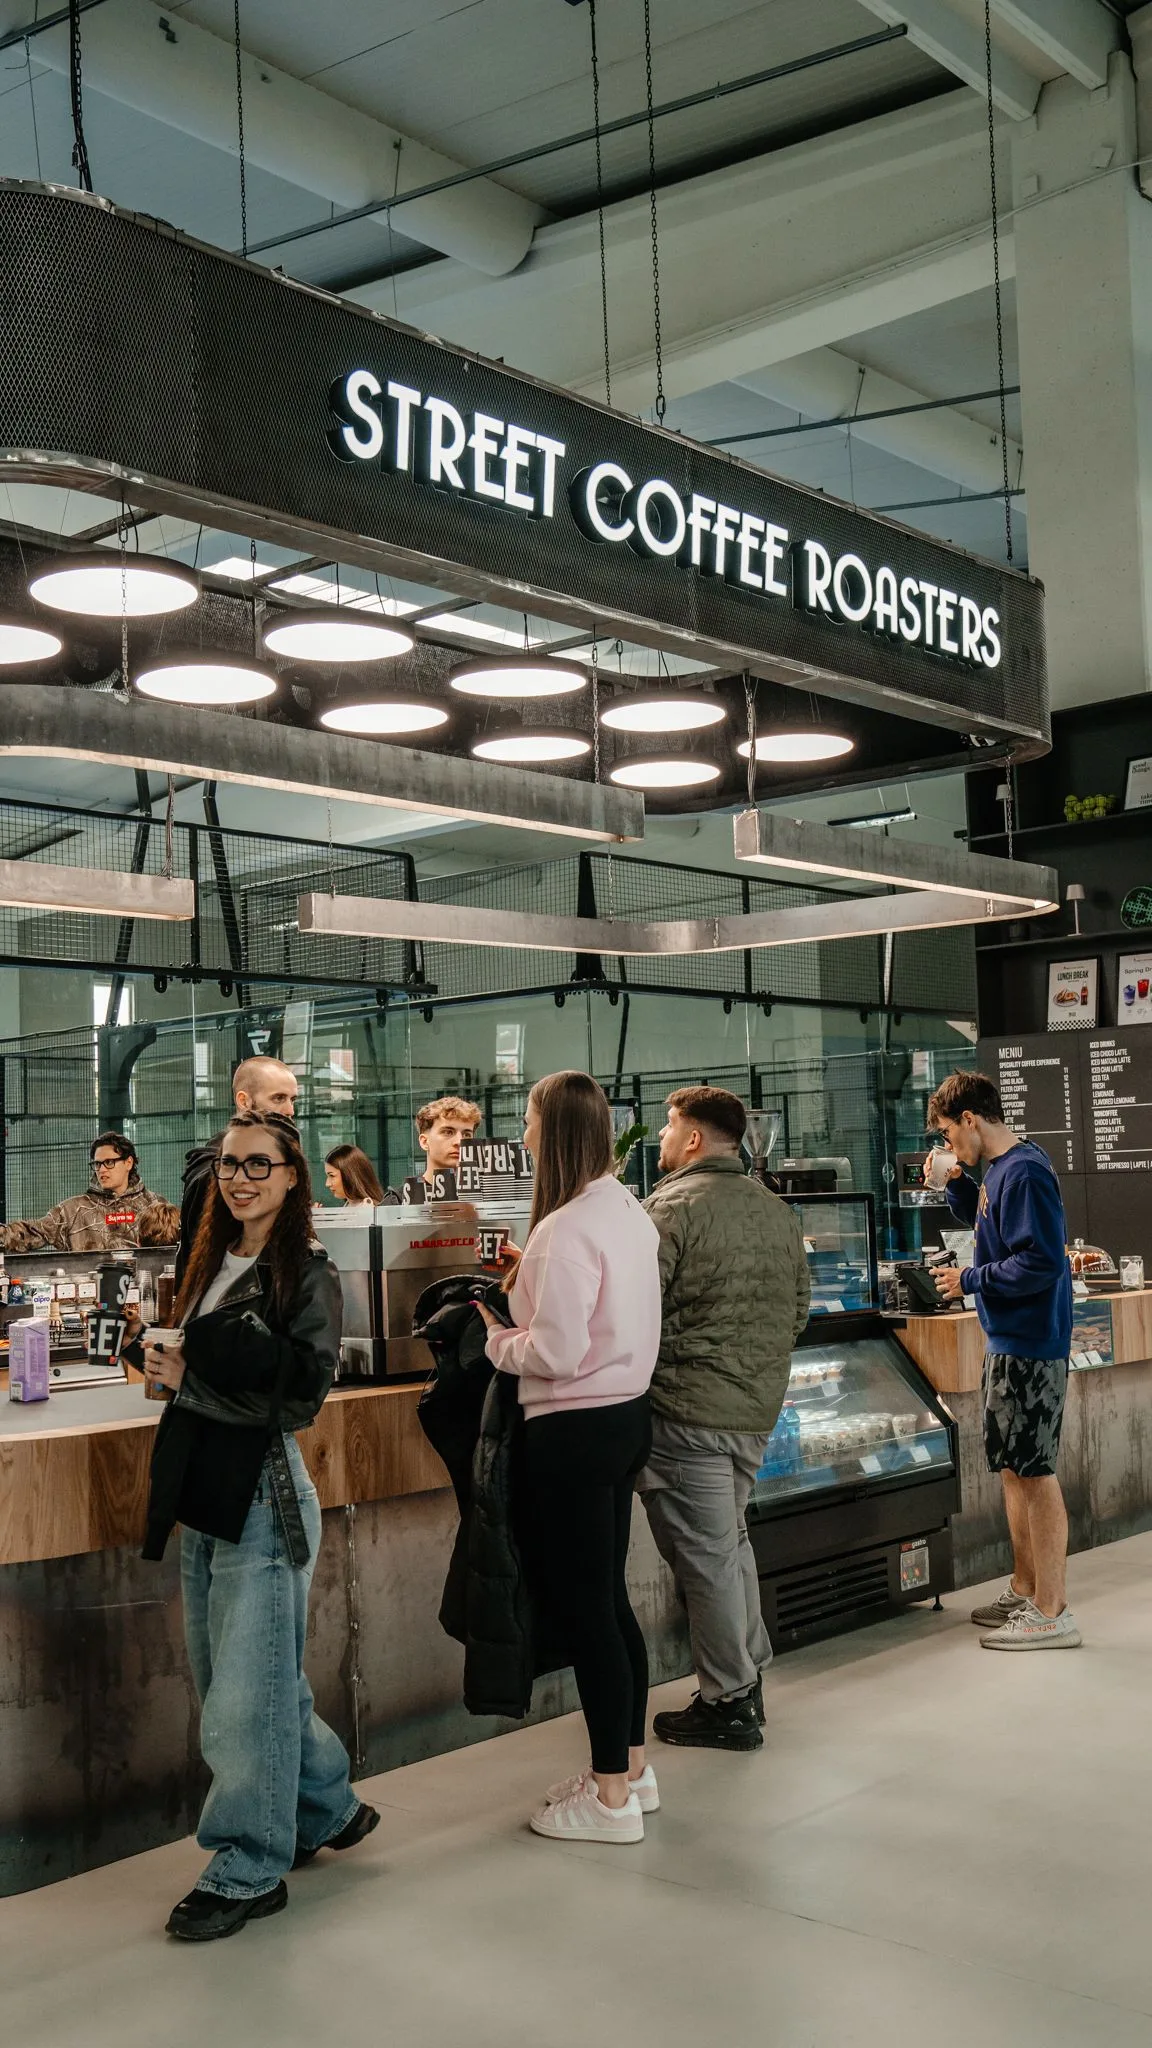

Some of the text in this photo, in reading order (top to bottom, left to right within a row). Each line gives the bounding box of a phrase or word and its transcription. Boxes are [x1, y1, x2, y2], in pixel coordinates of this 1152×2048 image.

[343, 370, 1001, 669] STREET COFFEE ROASTERS
[1058, 970, 1088, 981] LUNCH BREAK
[999, 1046, 1022, 1059] MENIU
[34, 1294, 50, 1304] alpro
